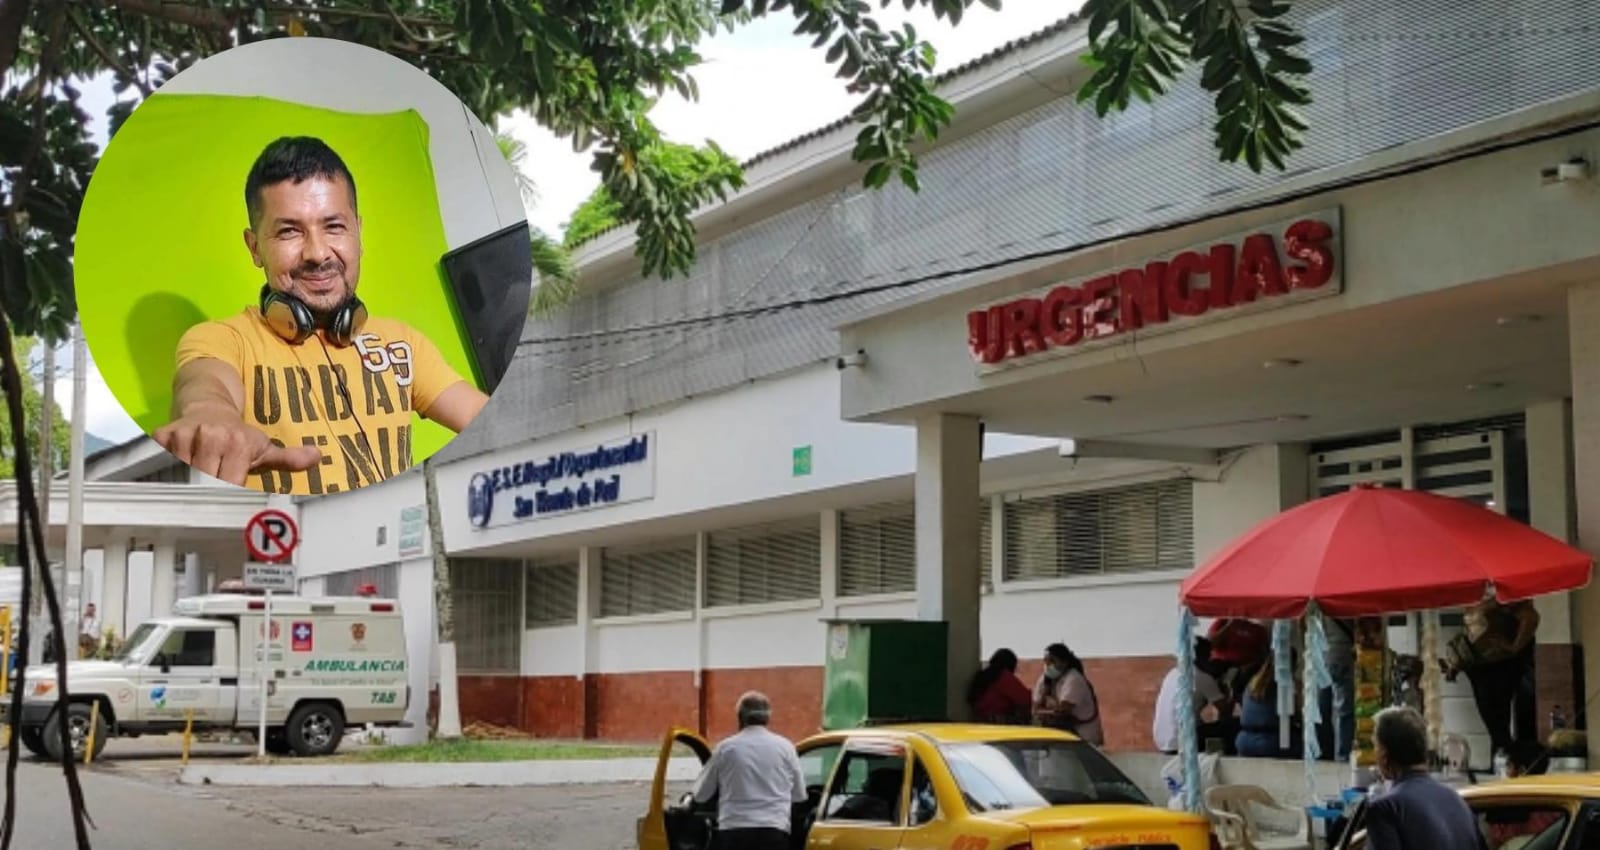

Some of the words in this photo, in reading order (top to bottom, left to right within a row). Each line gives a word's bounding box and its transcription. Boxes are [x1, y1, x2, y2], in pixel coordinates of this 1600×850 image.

[967, 218, 1335, 364] URGENCIAS
[353, 333, 413, 387] 59
[262, 518, 287, 551] P
[304, 659, 405, 672] AMBULANCIA
